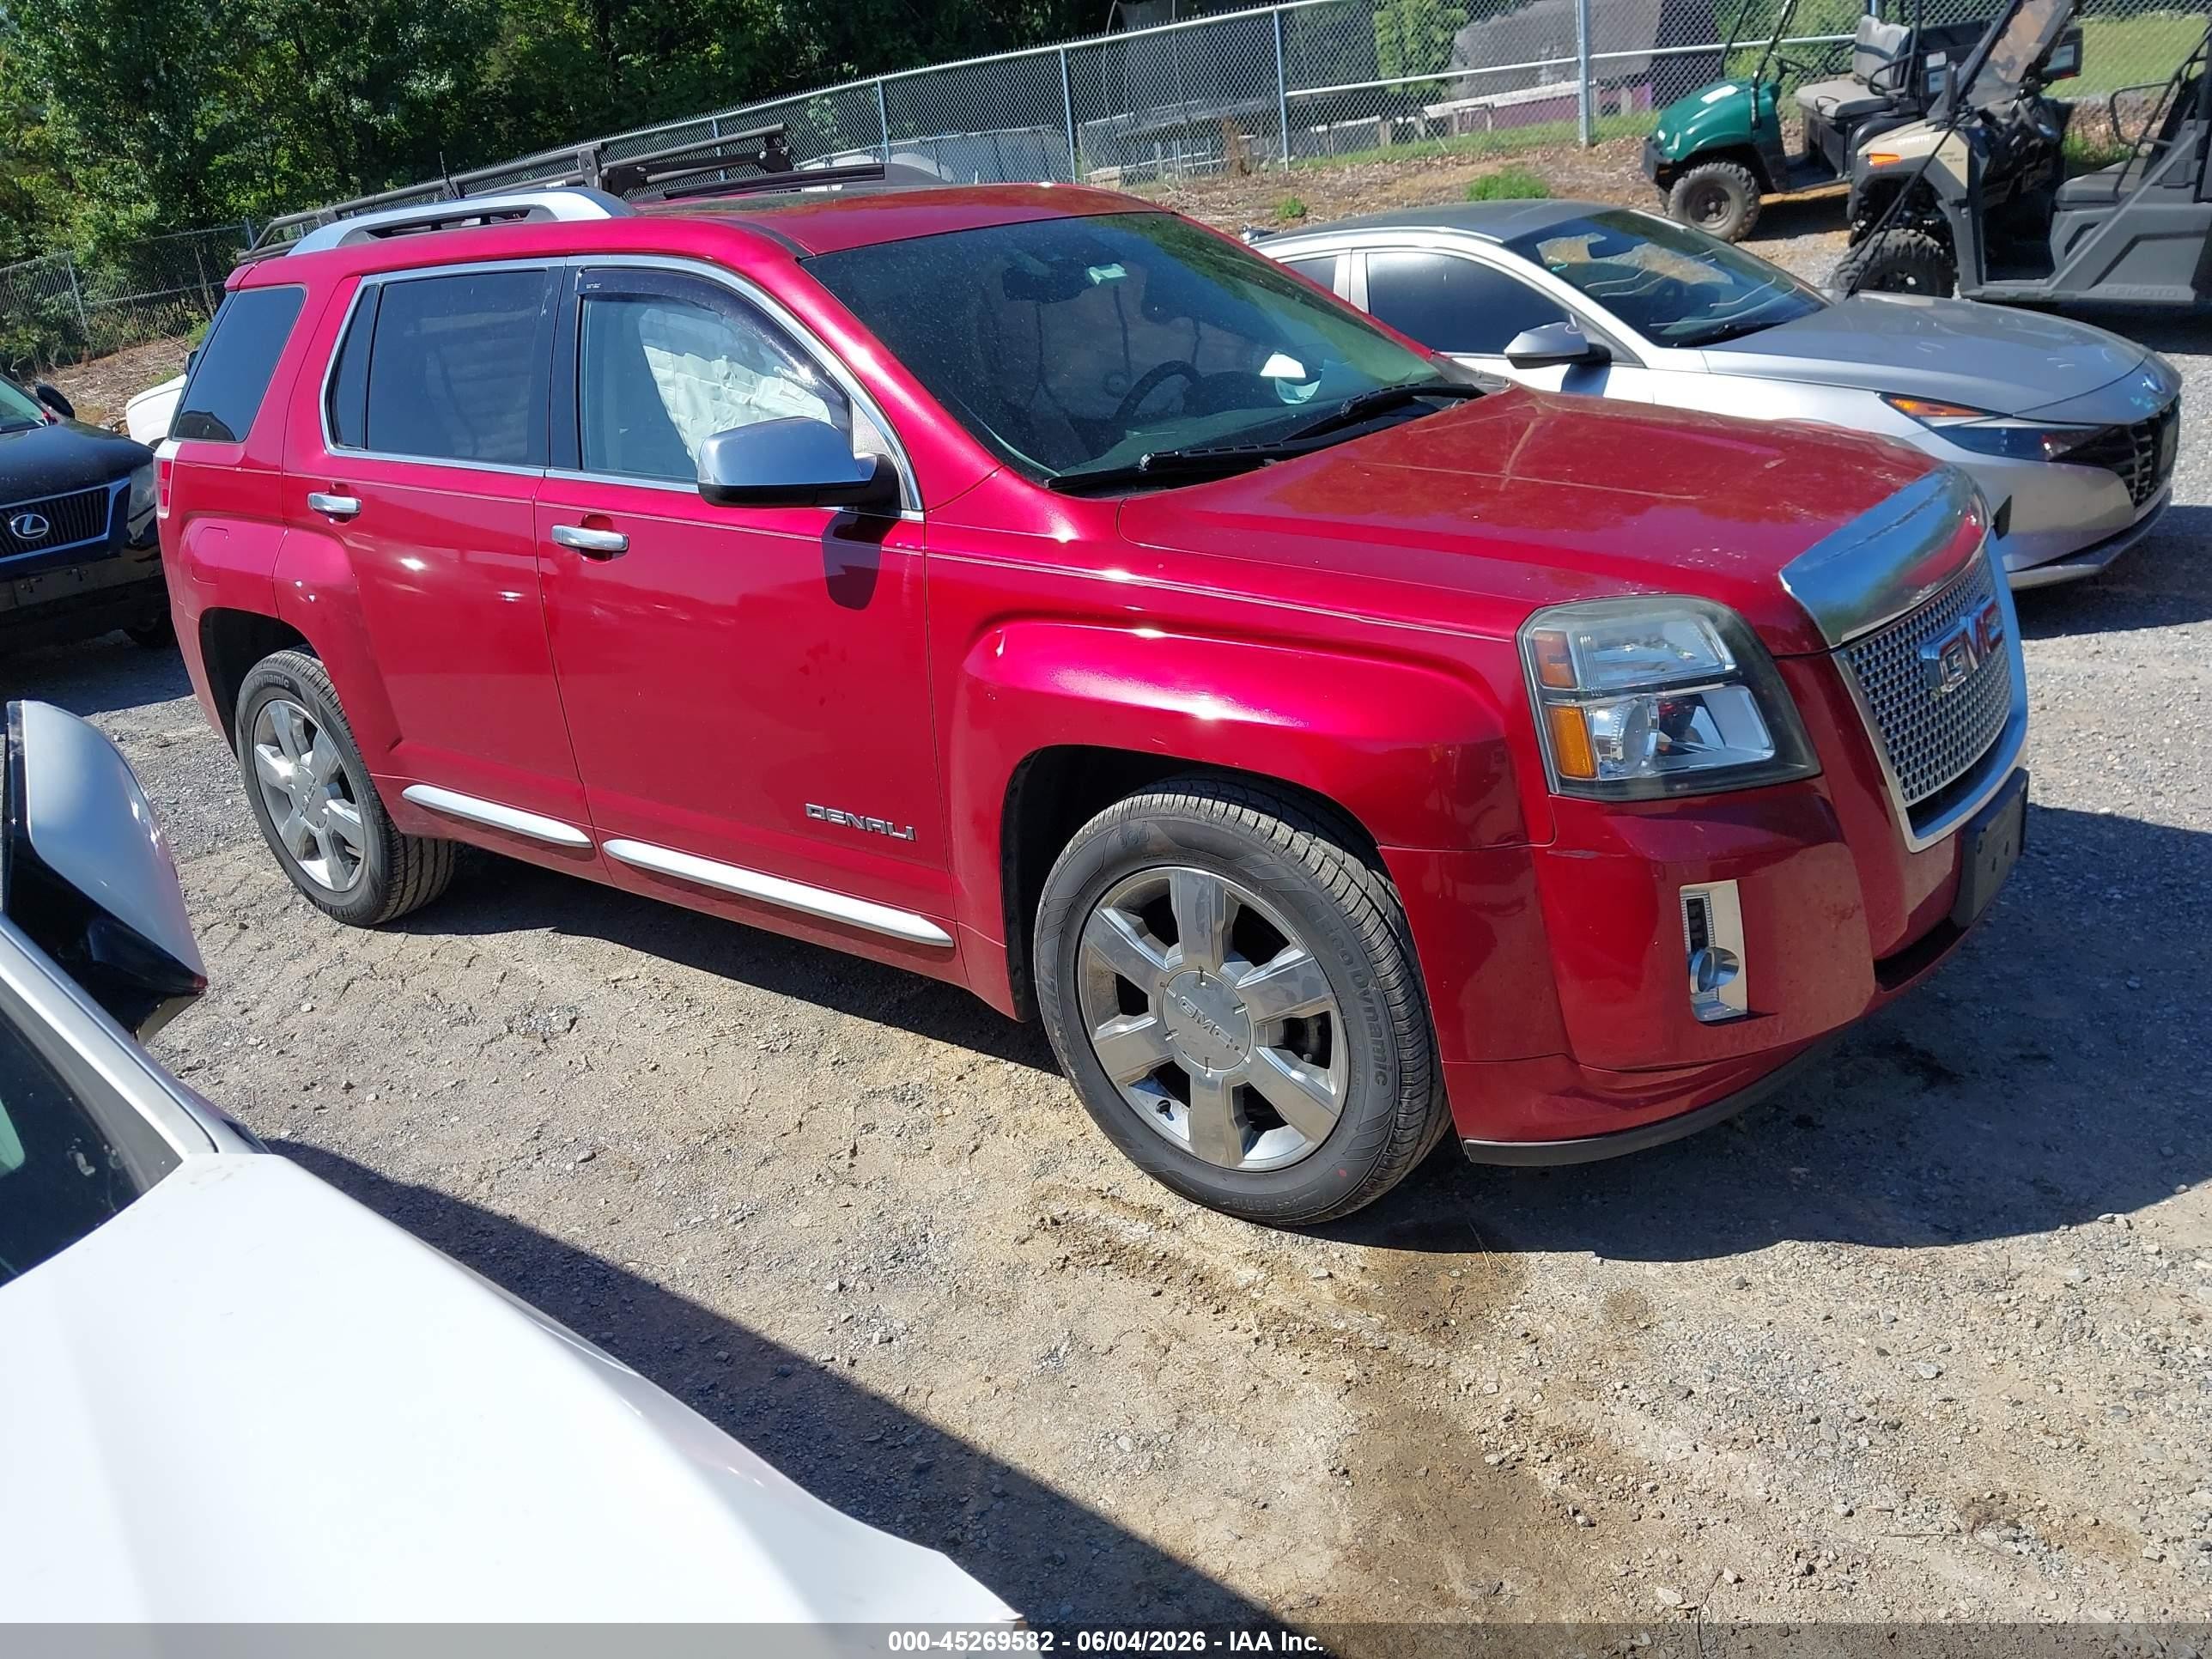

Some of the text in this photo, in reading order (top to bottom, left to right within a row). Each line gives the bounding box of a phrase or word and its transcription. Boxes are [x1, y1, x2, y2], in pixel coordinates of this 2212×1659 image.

[1939, 599, 2003, 692] GMC
[805, 803, 916, 841] DENALI
[1178, 996, 1234, 1049] GMC
